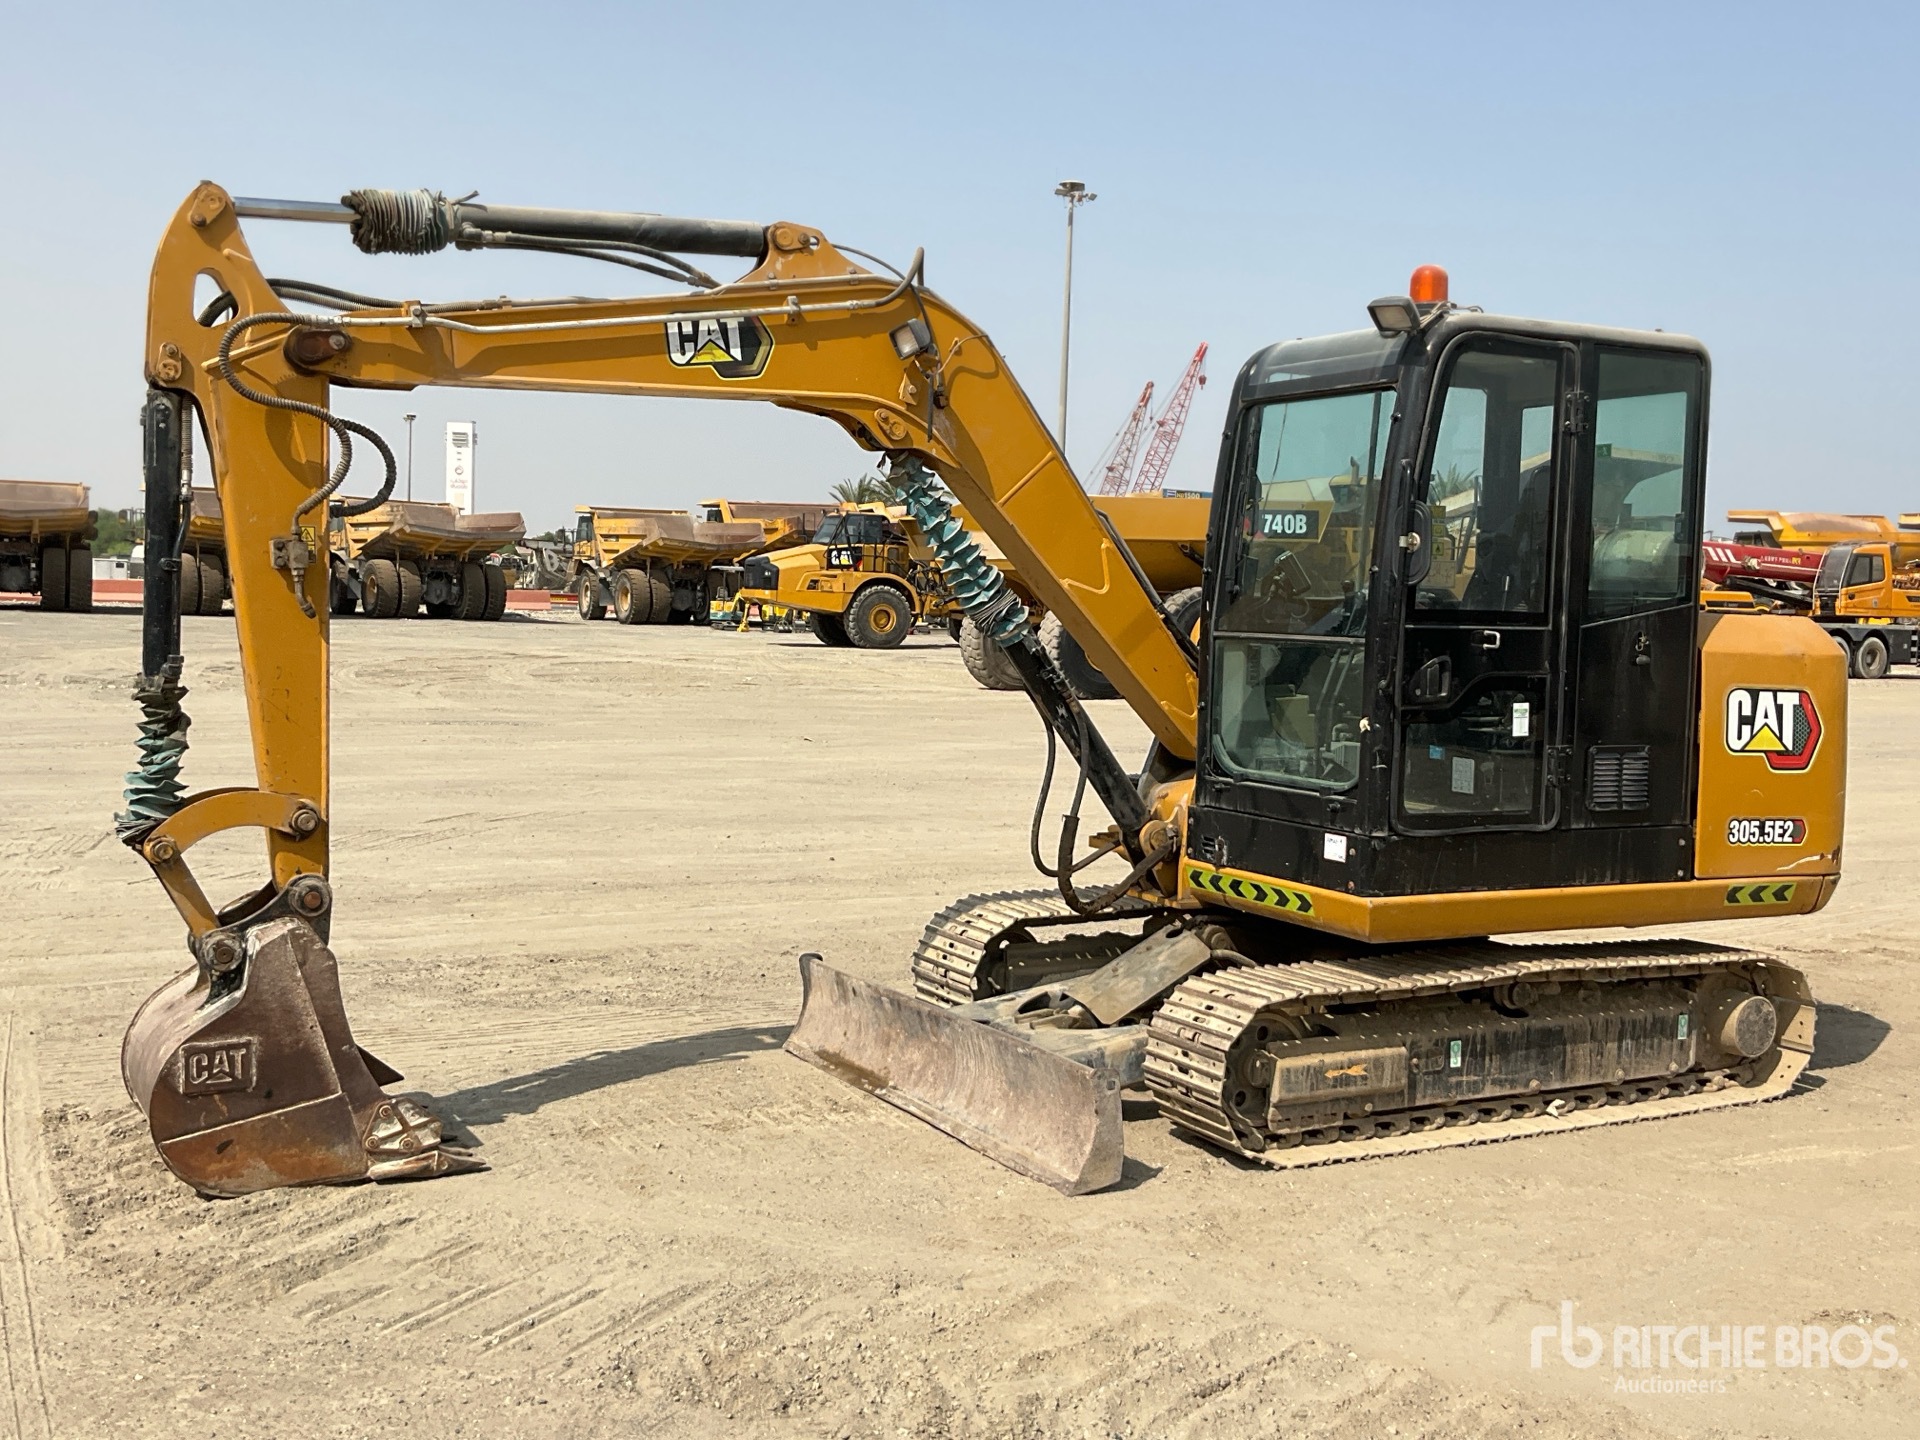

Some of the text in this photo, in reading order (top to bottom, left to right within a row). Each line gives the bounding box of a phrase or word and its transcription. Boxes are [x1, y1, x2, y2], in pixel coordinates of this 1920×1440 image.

[666, 317, 745, 365] CAT
[1263, 514, 1307, 534] 740B
[1727, 689, 1800, 751] CAT
[1728, 820, 1794, 843] 305.5E2
[189, 1048, 247, 1084] CAT
